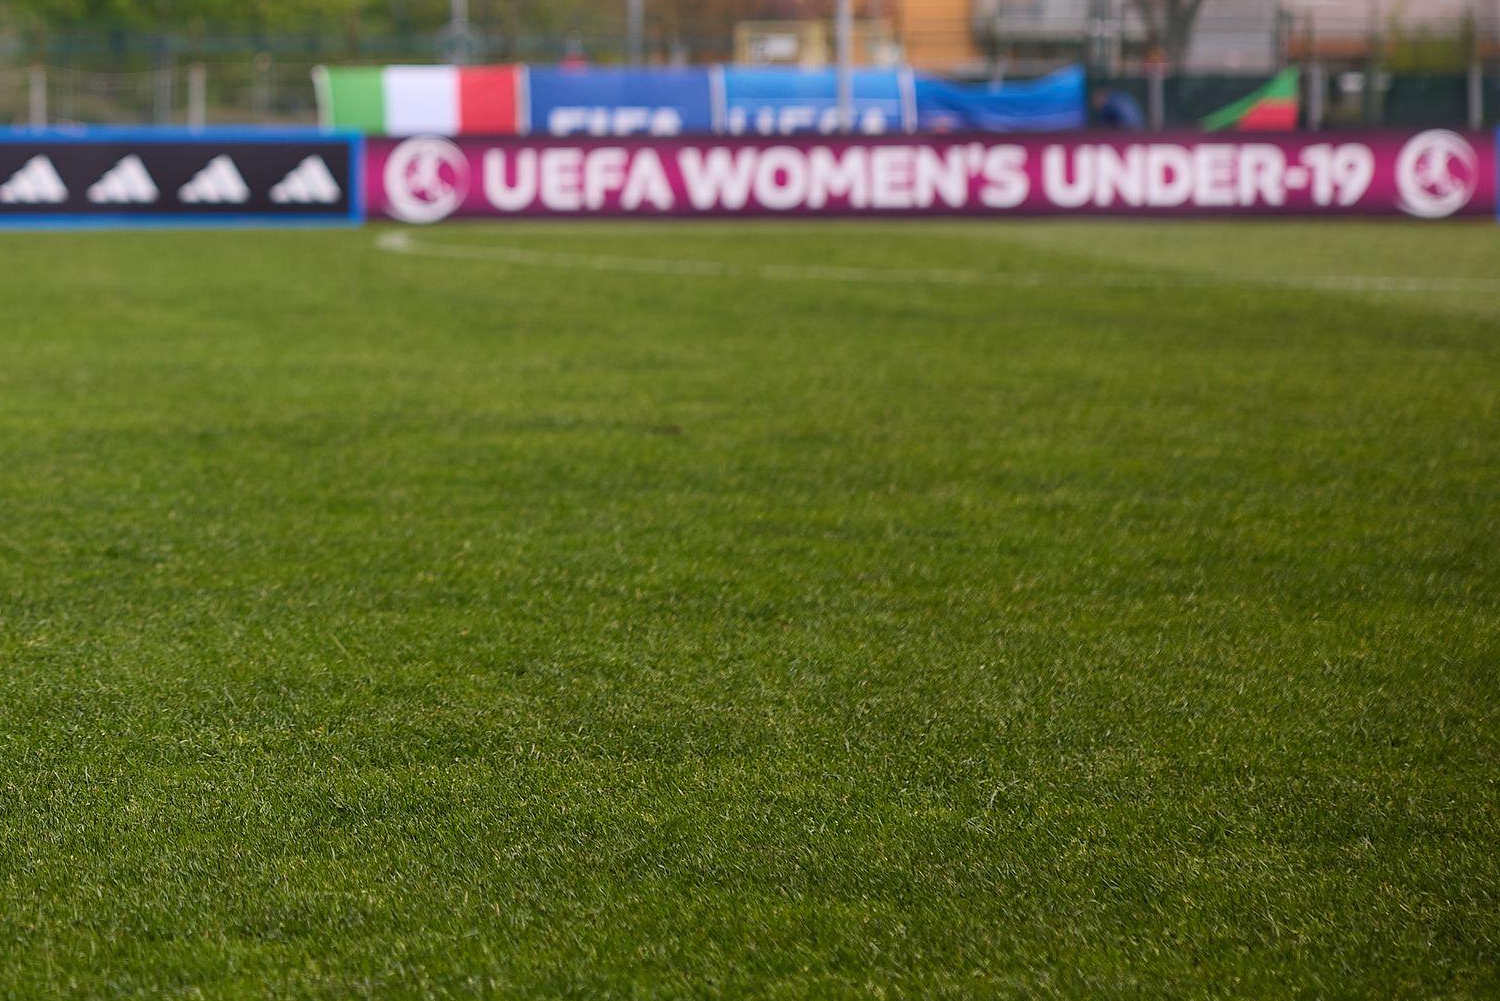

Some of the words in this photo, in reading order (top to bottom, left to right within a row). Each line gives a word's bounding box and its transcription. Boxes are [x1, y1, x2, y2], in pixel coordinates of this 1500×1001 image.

[548, 105, 683, 137] FIFA
[483, 147, 674, 210] UEFA
[678, 143, 1030, 209] WOMEN'S
[1041, 143, 1376, 208] UNDER-19
